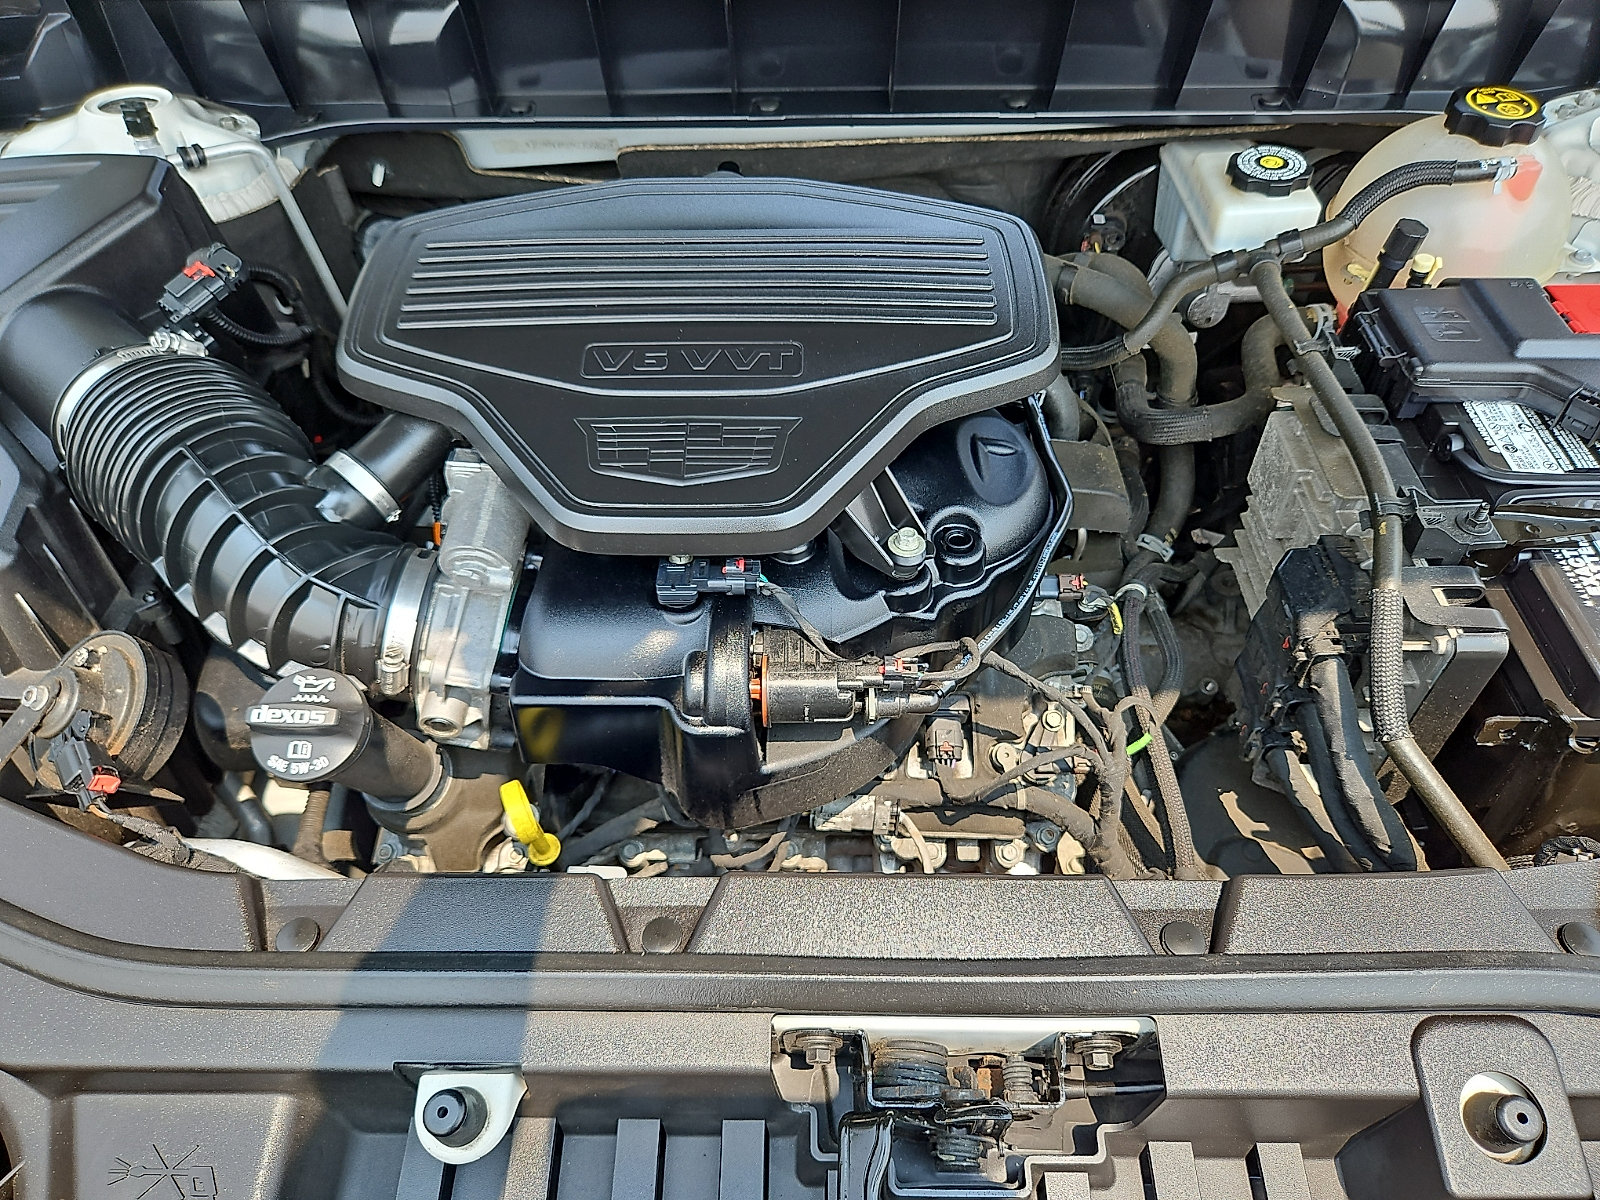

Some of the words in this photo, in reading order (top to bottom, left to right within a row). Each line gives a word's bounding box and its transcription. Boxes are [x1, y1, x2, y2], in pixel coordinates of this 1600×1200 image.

[593, 350, 669, 371] V6
[681, 348, 795, 371] VVT
[250, 705, 329, 723] dexos
[268, 755, 289, 772] SAE
[290, 756, 329, 774] 5W-30
